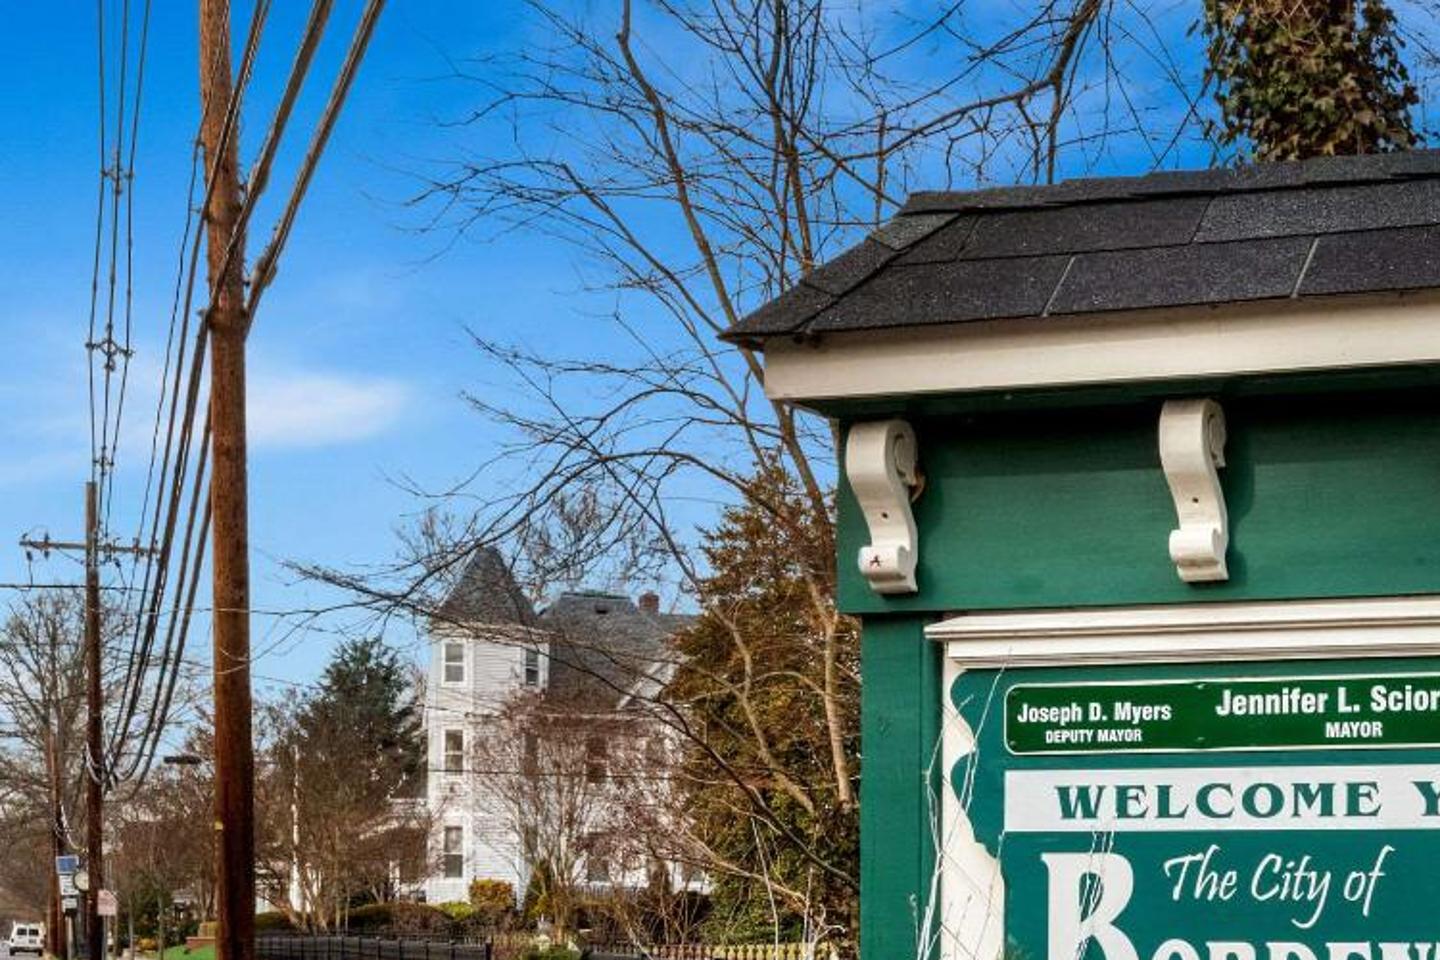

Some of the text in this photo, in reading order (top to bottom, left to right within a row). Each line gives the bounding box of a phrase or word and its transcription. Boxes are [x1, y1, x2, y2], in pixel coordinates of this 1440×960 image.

[1017, 702, 1173, 727] Joseph D. Myers
[1215, 687, 1329, 716] Jennifer
[1338, 687, 1361, 713] L.
[1045, 729, 1143, 744] DEPUTY MAYOR
[1325, 720, 1384, 739] MAYOR
[1055, 781, 1382, 820] WELCOME
[1164, 844, 1395, 929] The City of
